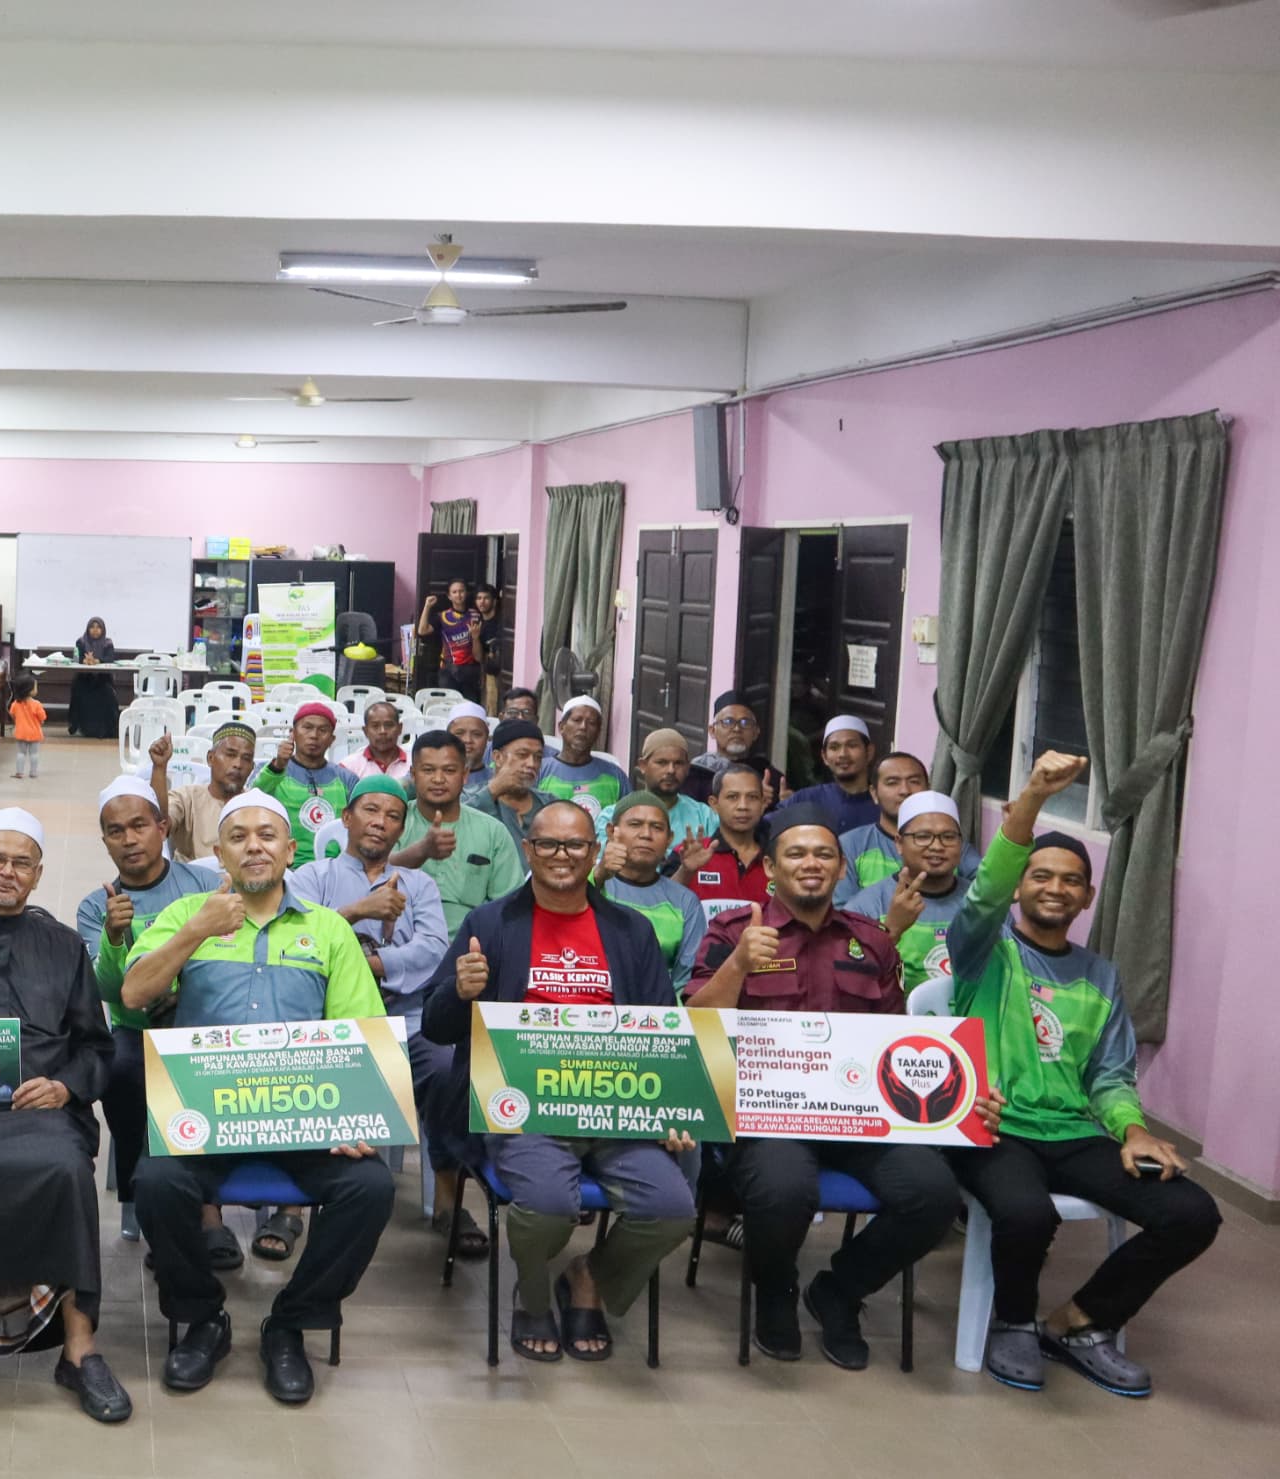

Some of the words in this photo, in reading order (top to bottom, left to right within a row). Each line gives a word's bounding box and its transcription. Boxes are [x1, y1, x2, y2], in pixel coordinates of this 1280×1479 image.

[534, 971, 565, 981] TASIK
[567, 972, 607, 984] KENYIR
[517, 1032, 570, 1042] HIMPUNAN
[574, 1034, 650, 1046] SUKARELAWAN
[653, 1037, 691, 1047] BANJIR
[530, 1040, 548, 1049] PAS
[552, 1041, 604, 1051] KAWASAN
[606, 1043, 650, 1052] DUNGUN
[652, 1044, 677, 1053] 2024
[736, 1035, 775, 1046] Pelan
[190, 1053, 245, 1064] HIMPUNAN
[247, 1048, 324, 1062] SUKARELAWAN
[326, 1047, 363, 1056] BANJIR
[737, 1046, 832, 1062] Perlindungan
[204, 1062, 224, 1070] PAS
[226, 1058, 278, 1069] KAWASAN
[280, 1056, 324, 1066] DUNGUN
[325, 1054, 350, 1064] 2024
[560, 1059, 638, 1071] SUMBANGAN
[738, 1059, 829, 1074] Kemalangan
[898, 1058, 944, 1068] TAKAFUL
[236, 1074, 314, 1087] SUMBANGAN
[738, 1070, 762, 1081] Diri
[905, 1069, 938, 1078] KASIH
[536, 1068, 662, 1100] RM500
[911, 1079, 931, 1088] Plus
[213, 1082, 341, 1115] RM500
[739, 1088, 754, 1098] 50
[756, 1089, 806, 1101] Petugas
[538, 1102, 614, 1118] KHIDMAT
[619, 1105, 705, 1121] MALAYSIA
[739, 1099, 799, 1110] Frontliner
[802, 1101, 828, 1111] JAM
[830, 1102, 879, 1115] Dungun
[218, 1118, 296, 1134] KHIDMAT
[300, 1113, 387, 1131] MALAYSIA
[577, 1117, 613, 1130] DUN
[618, 1119, 664, 1132] PAKA
[738, 1114, 785, 1123] HIMPUNAN
[786, 1116, 850, 1126] SUKARELAWAN
[852, 1118, 882, 1127] BANJIR
[757, 1123, 802, 1132] KAWASAN
[804, 1125, 841, 1133] DUNGUN
[842, 1126, 864, 1134] 2024
[216, 1133, 253, 1147] DUN
[257, 1128, 325, 1145] RANTAU
[330, 1126, 391, 1142] ABANG
